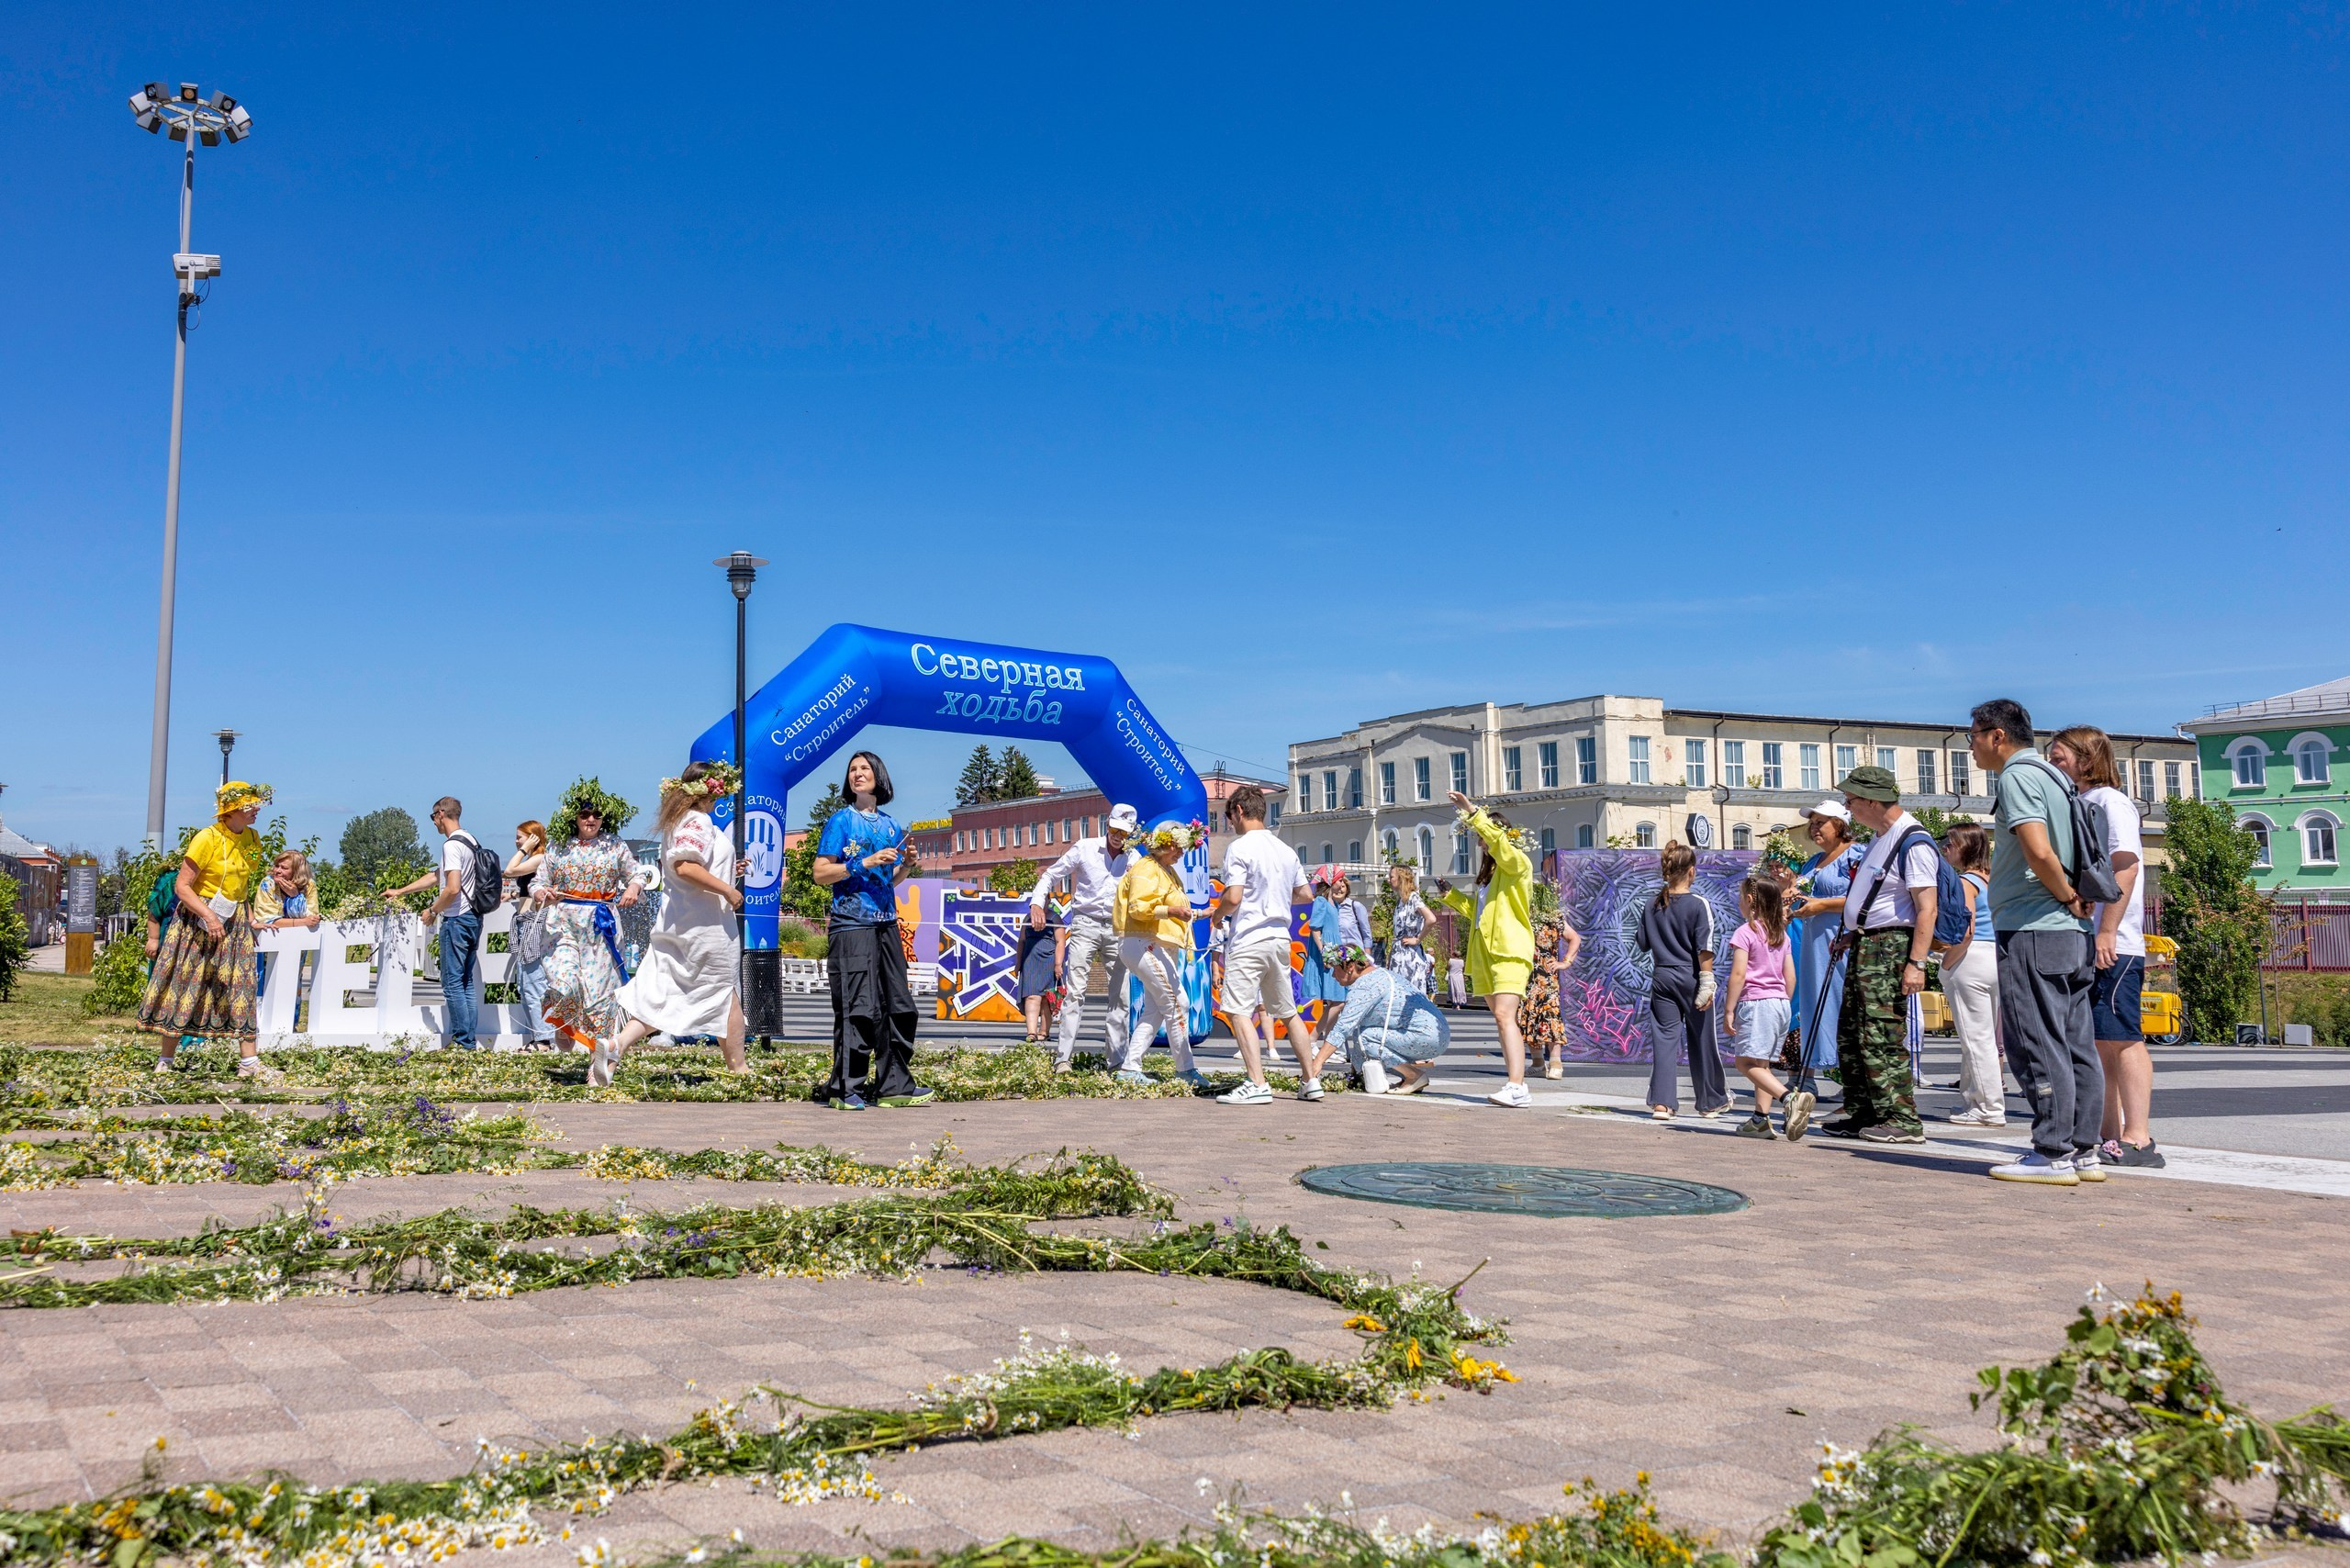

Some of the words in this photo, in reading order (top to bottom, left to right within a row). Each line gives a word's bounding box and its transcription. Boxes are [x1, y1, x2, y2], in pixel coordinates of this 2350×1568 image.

[911, 643, 1085, 694] Северная
[771, 673, 856, 745] Санаторий
[935, 689, 1063, 724] ходьба
[1126, 698, 1185, 776] Санаторий
